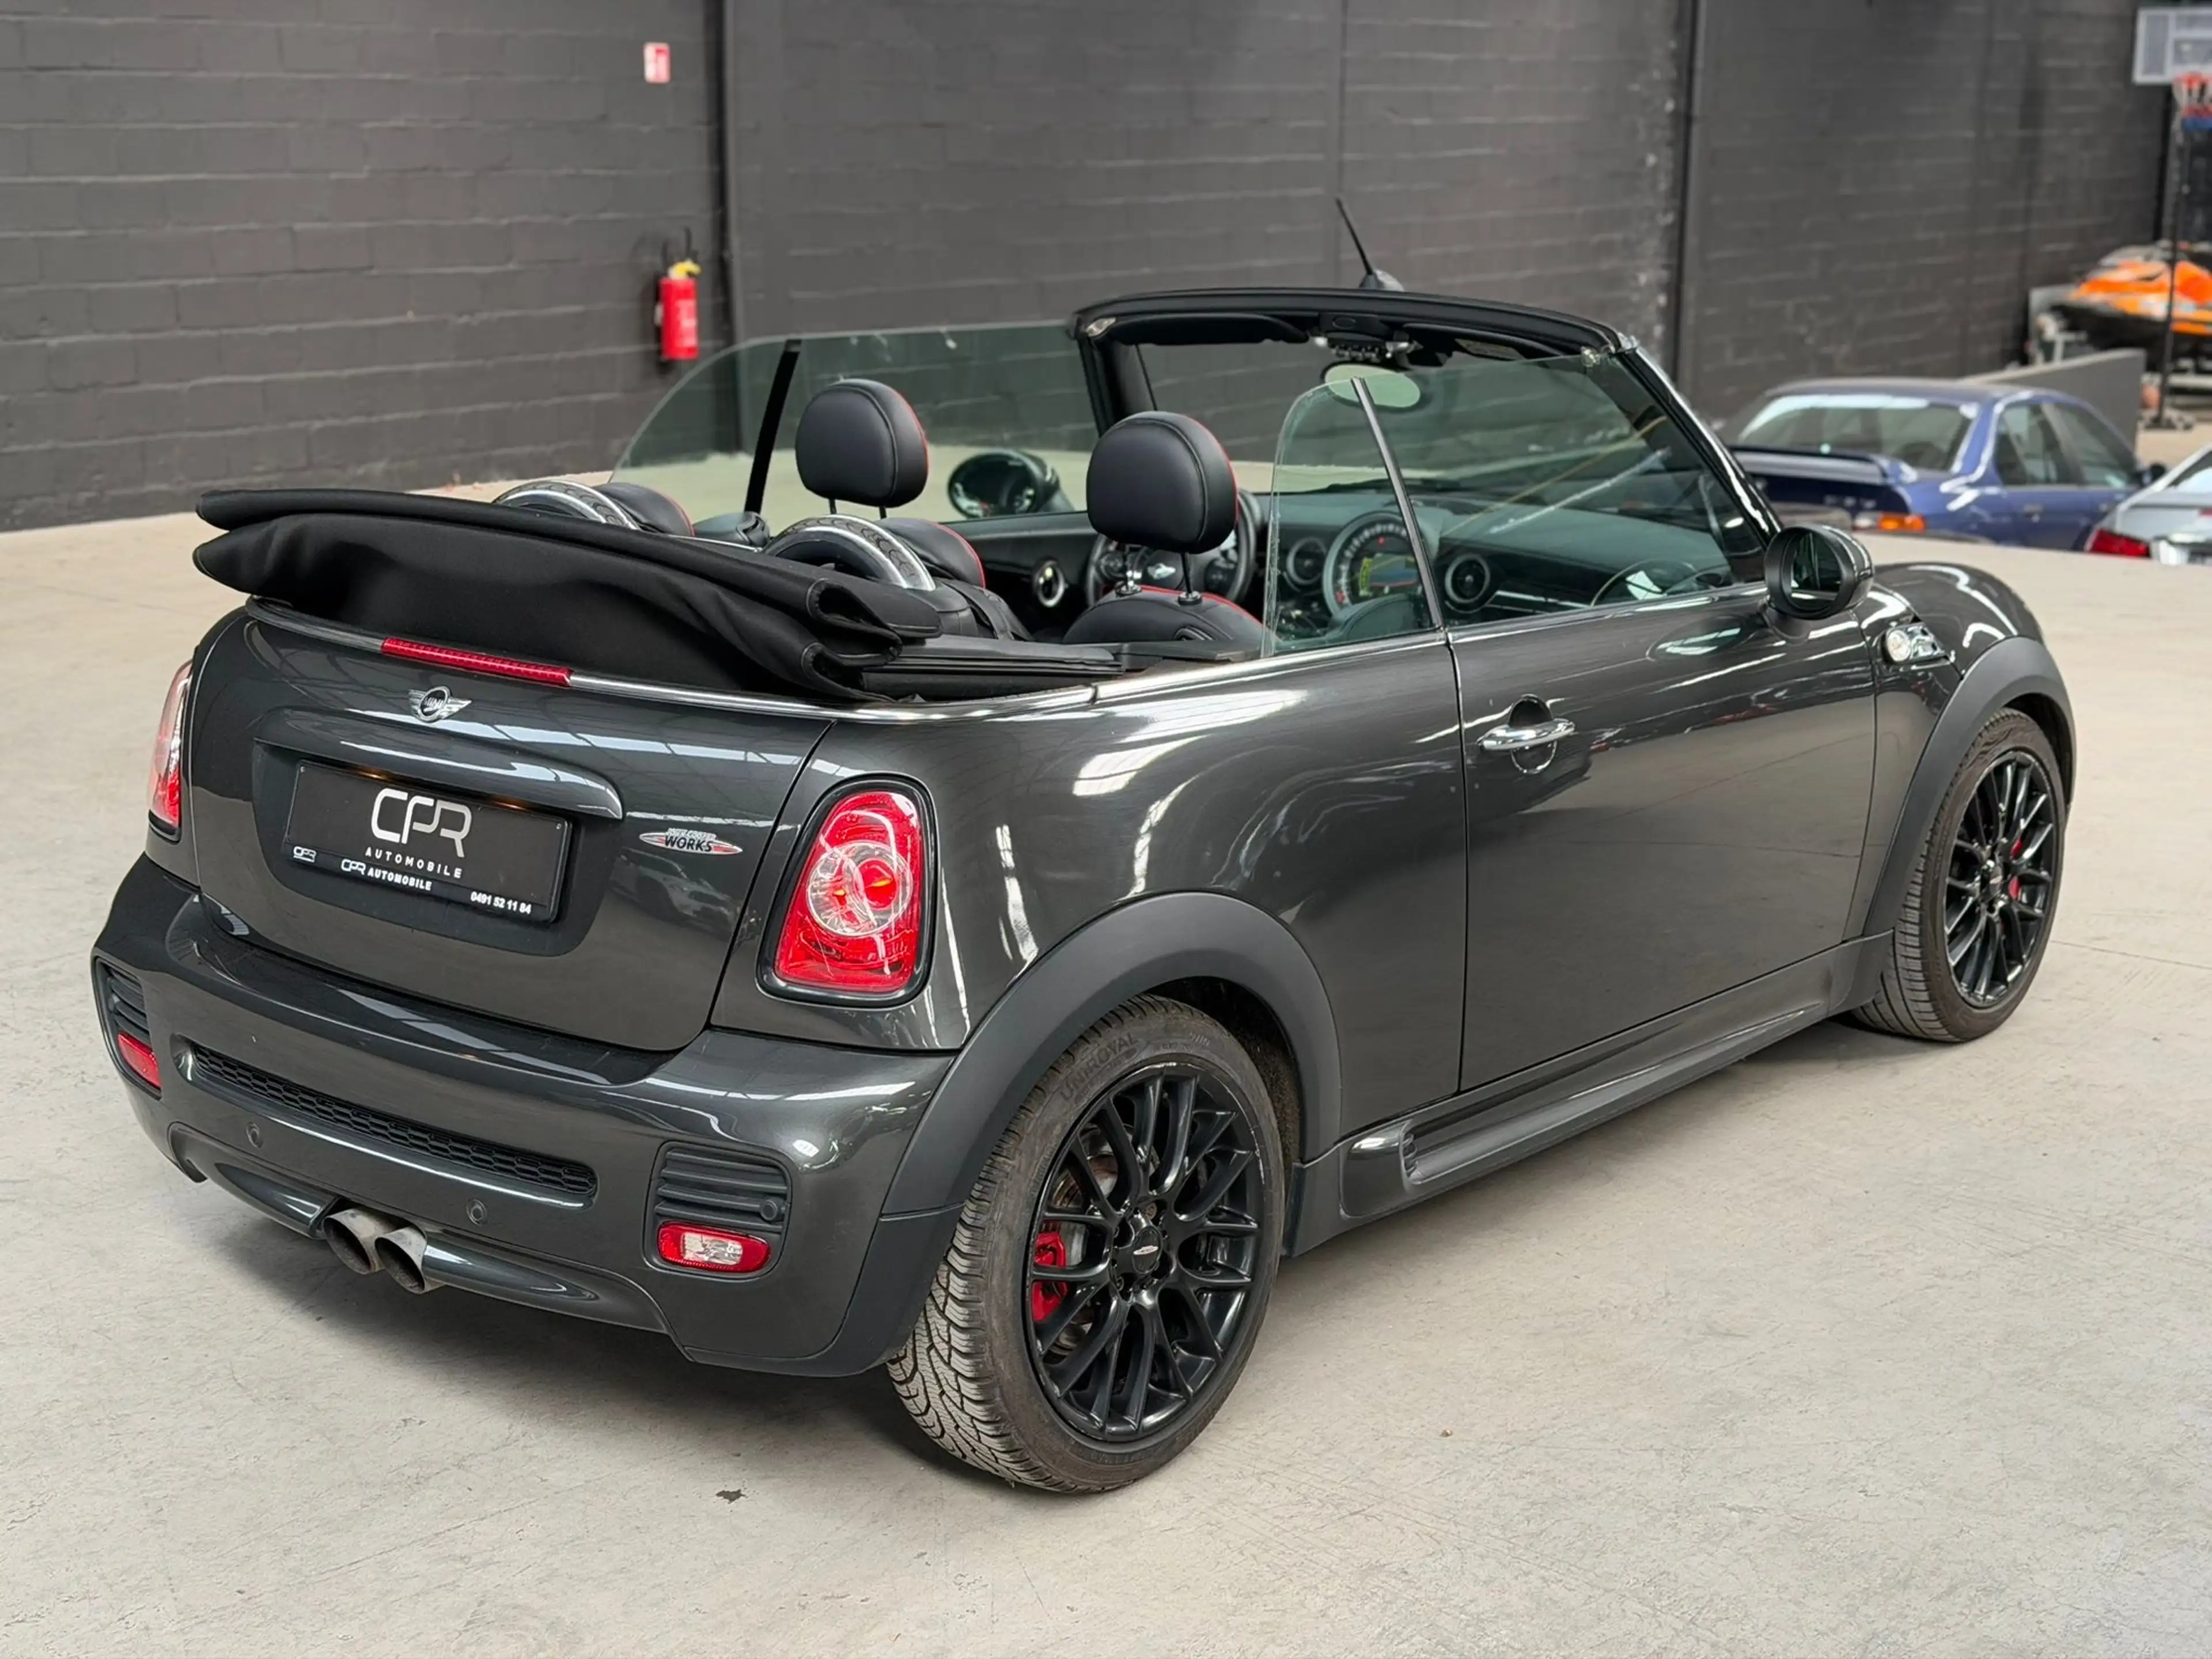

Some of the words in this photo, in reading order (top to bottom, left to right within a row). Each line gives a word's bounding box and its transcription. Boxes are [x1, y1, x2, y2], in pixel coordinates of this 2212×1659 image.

[371, 788, 472, 858] CPR
[665, 835, 714, 851] WORKS
[341, 859, 366, 875] CPR
[368, 867, 432, 891] AUTOMOBILE
[365, 847, 462, 878] AUTOMOBILE
[471, 891, 492, 905] 0491
[493, 896, 505, 908] 52
[507, 899, 518, 911] 11
[520, 902, 532, 914] 84
